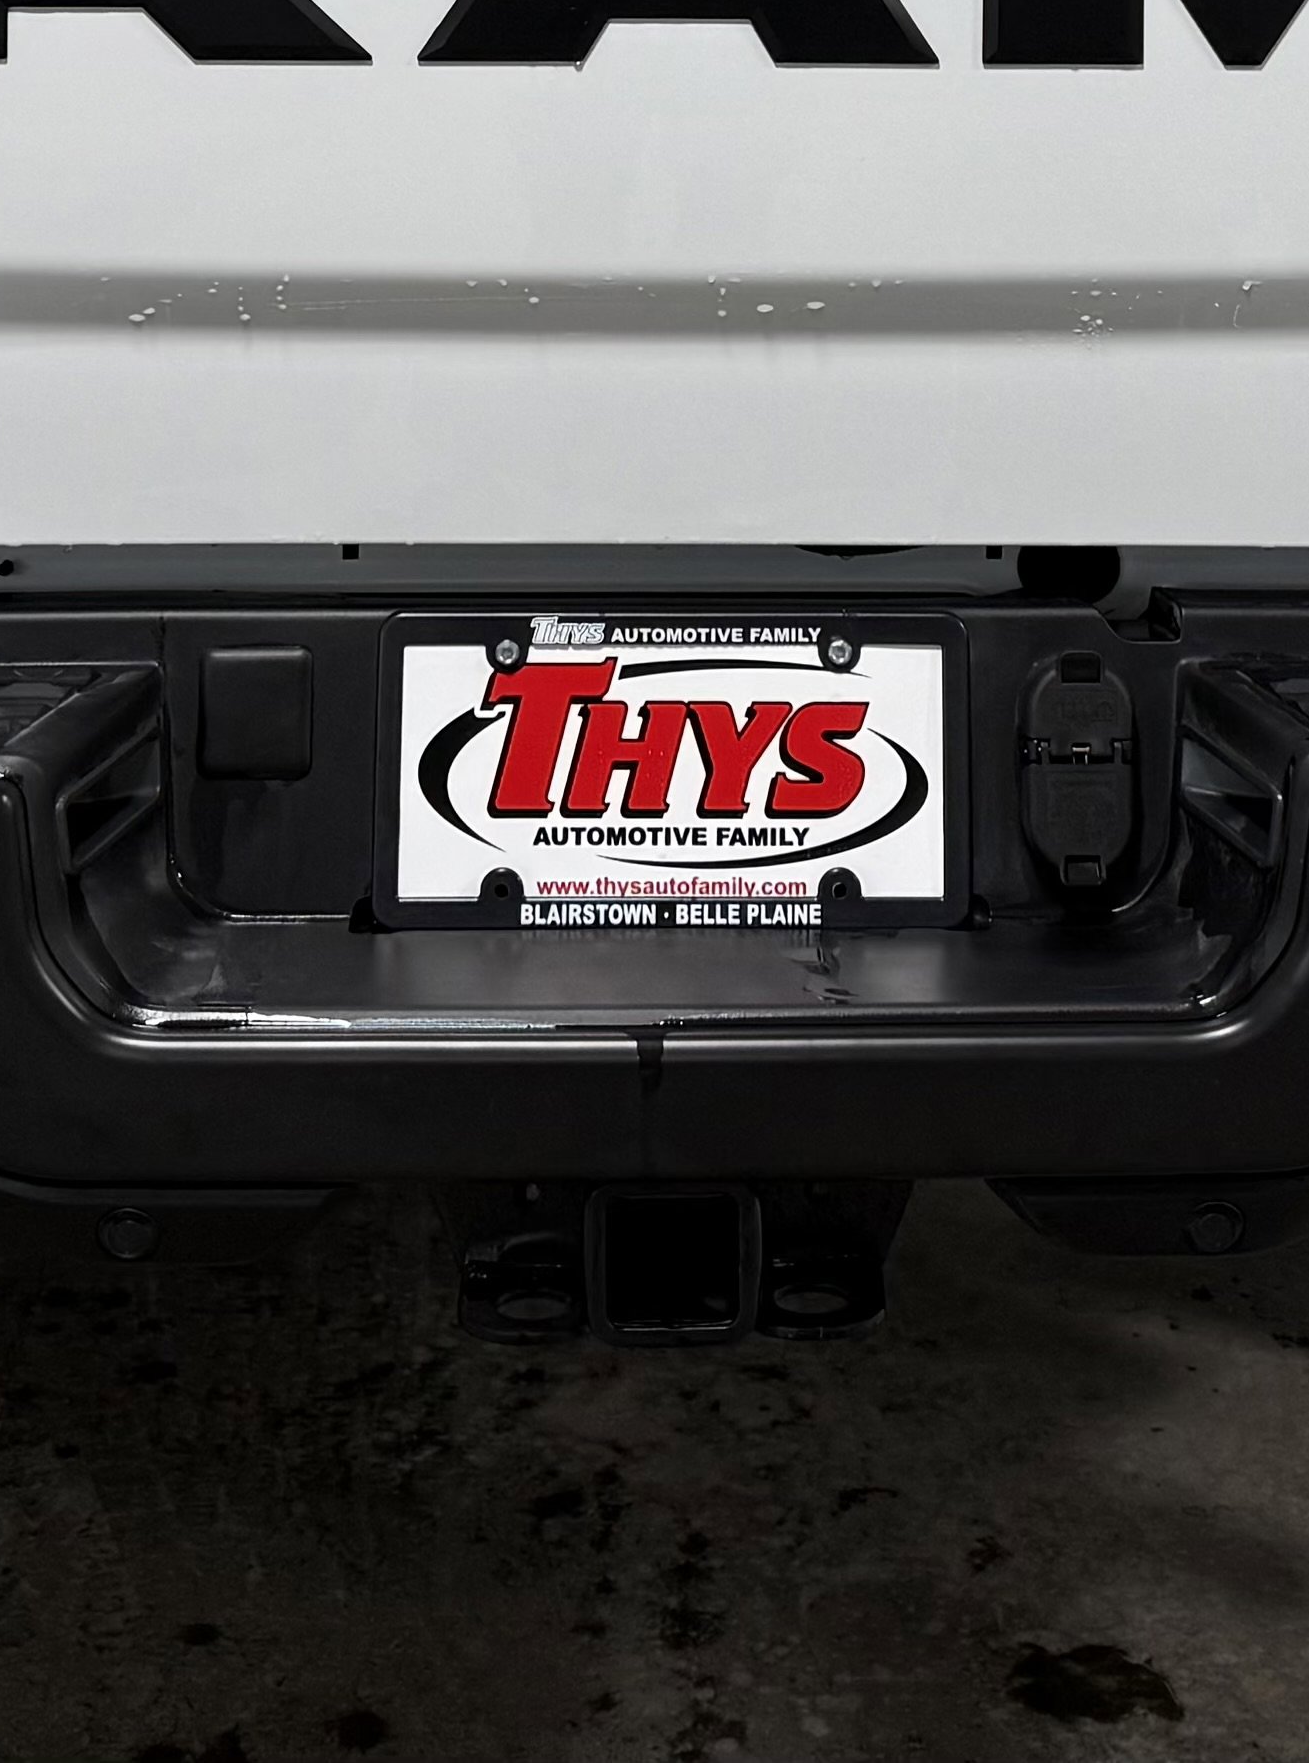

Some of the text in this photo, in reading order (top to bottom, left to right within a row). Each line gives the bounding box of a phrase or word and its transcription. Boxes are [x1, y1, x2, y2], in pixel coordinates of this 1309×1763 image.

[530, 616, 822, 645] THYS AUTOMOTIVE FAMILY
[487, 657, 869, 818] THYS
[532, 827, 810, 846] AUTOMOTIVE FAMILY
[536, 876, 807, 898] www.thysautofamily.com
[520, 904, 822, 925] BLAIRSTOWN BELLE PLAINE
